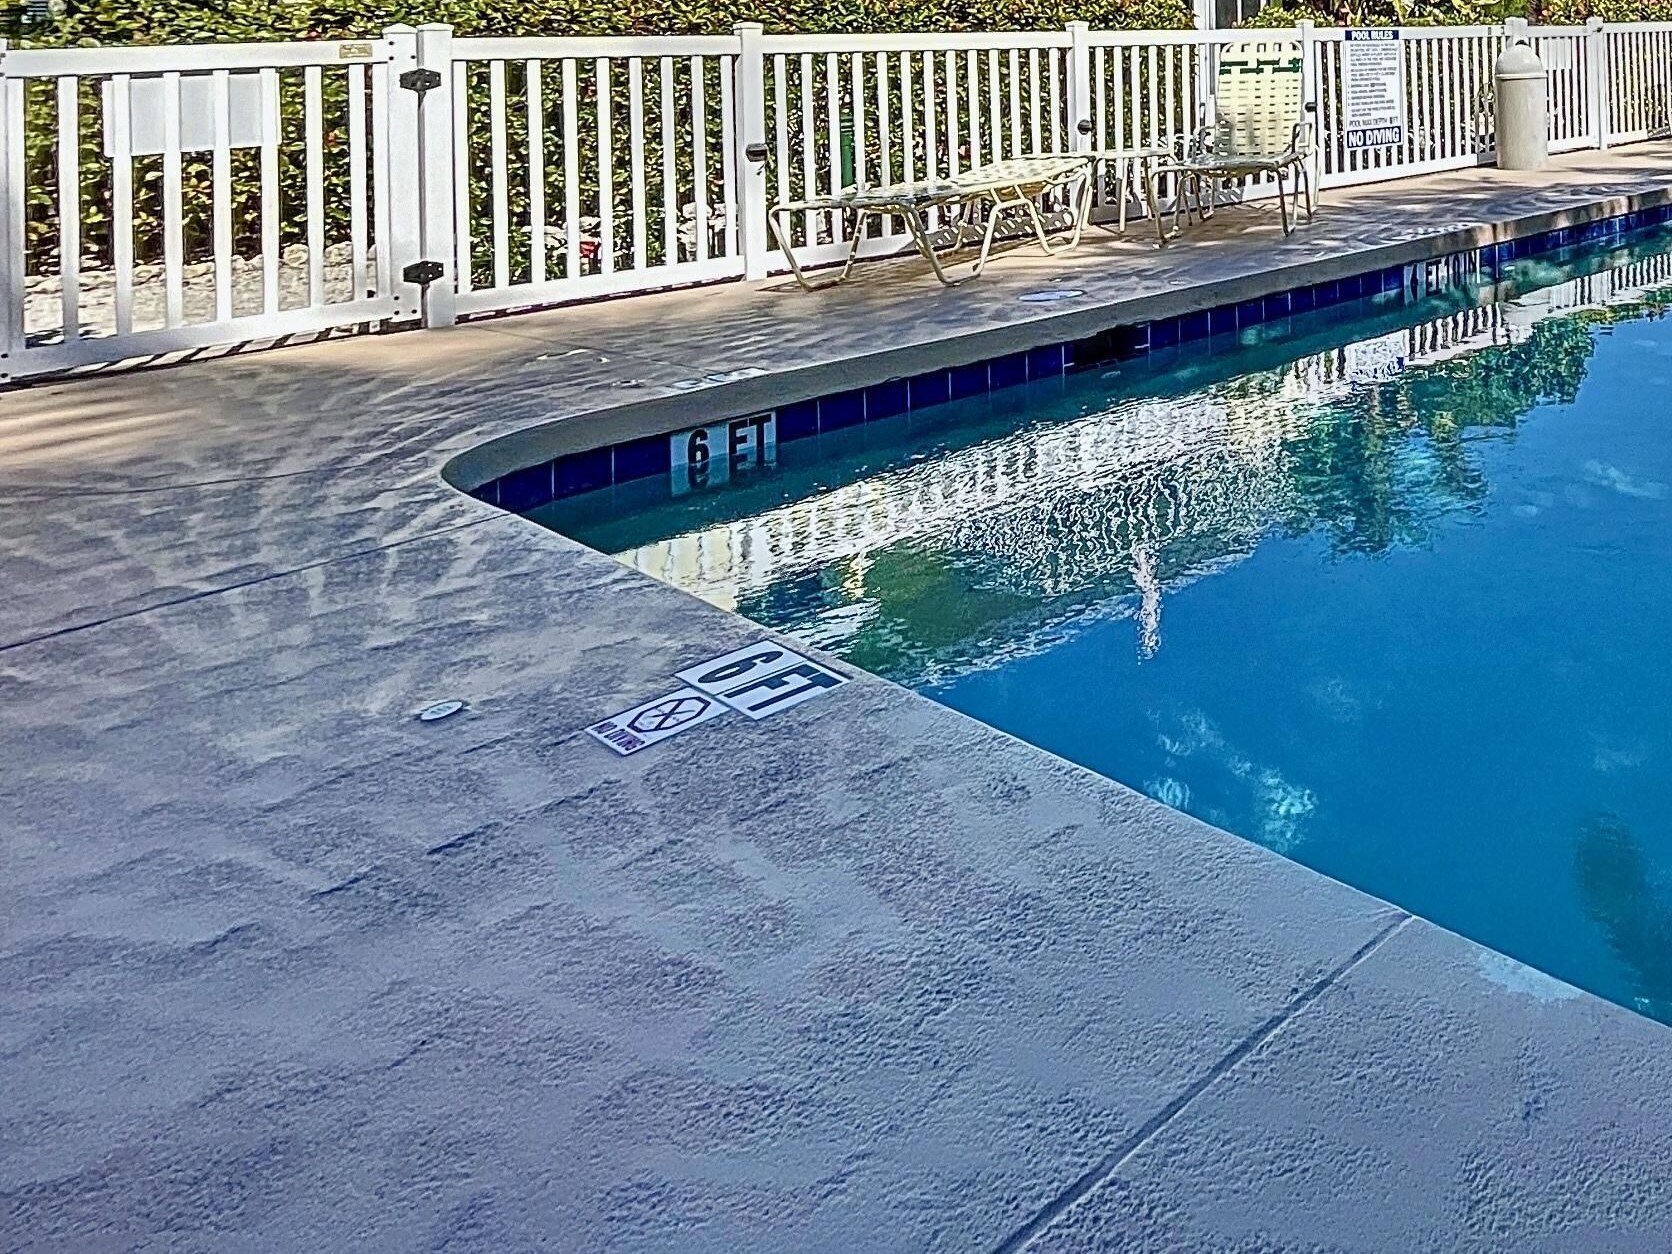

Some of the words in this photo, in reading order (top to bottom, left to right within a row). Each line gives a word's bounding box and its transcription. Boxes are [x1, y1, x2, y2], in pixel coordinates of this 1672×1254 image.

[1352, 30, 1370, 40] POOL
[1371, 30, 1393, 40] RULES
[1348, 131, 1364, 147] NO
[1365, 127, 1400, 145] DIVING
[688, 428, 709, 464] 6
[729, 414, 772, 455] FT
[697, 650, 783, 684] 6
[723, 663, 843, 712] FT
[591, 720, 618, 734] NO
